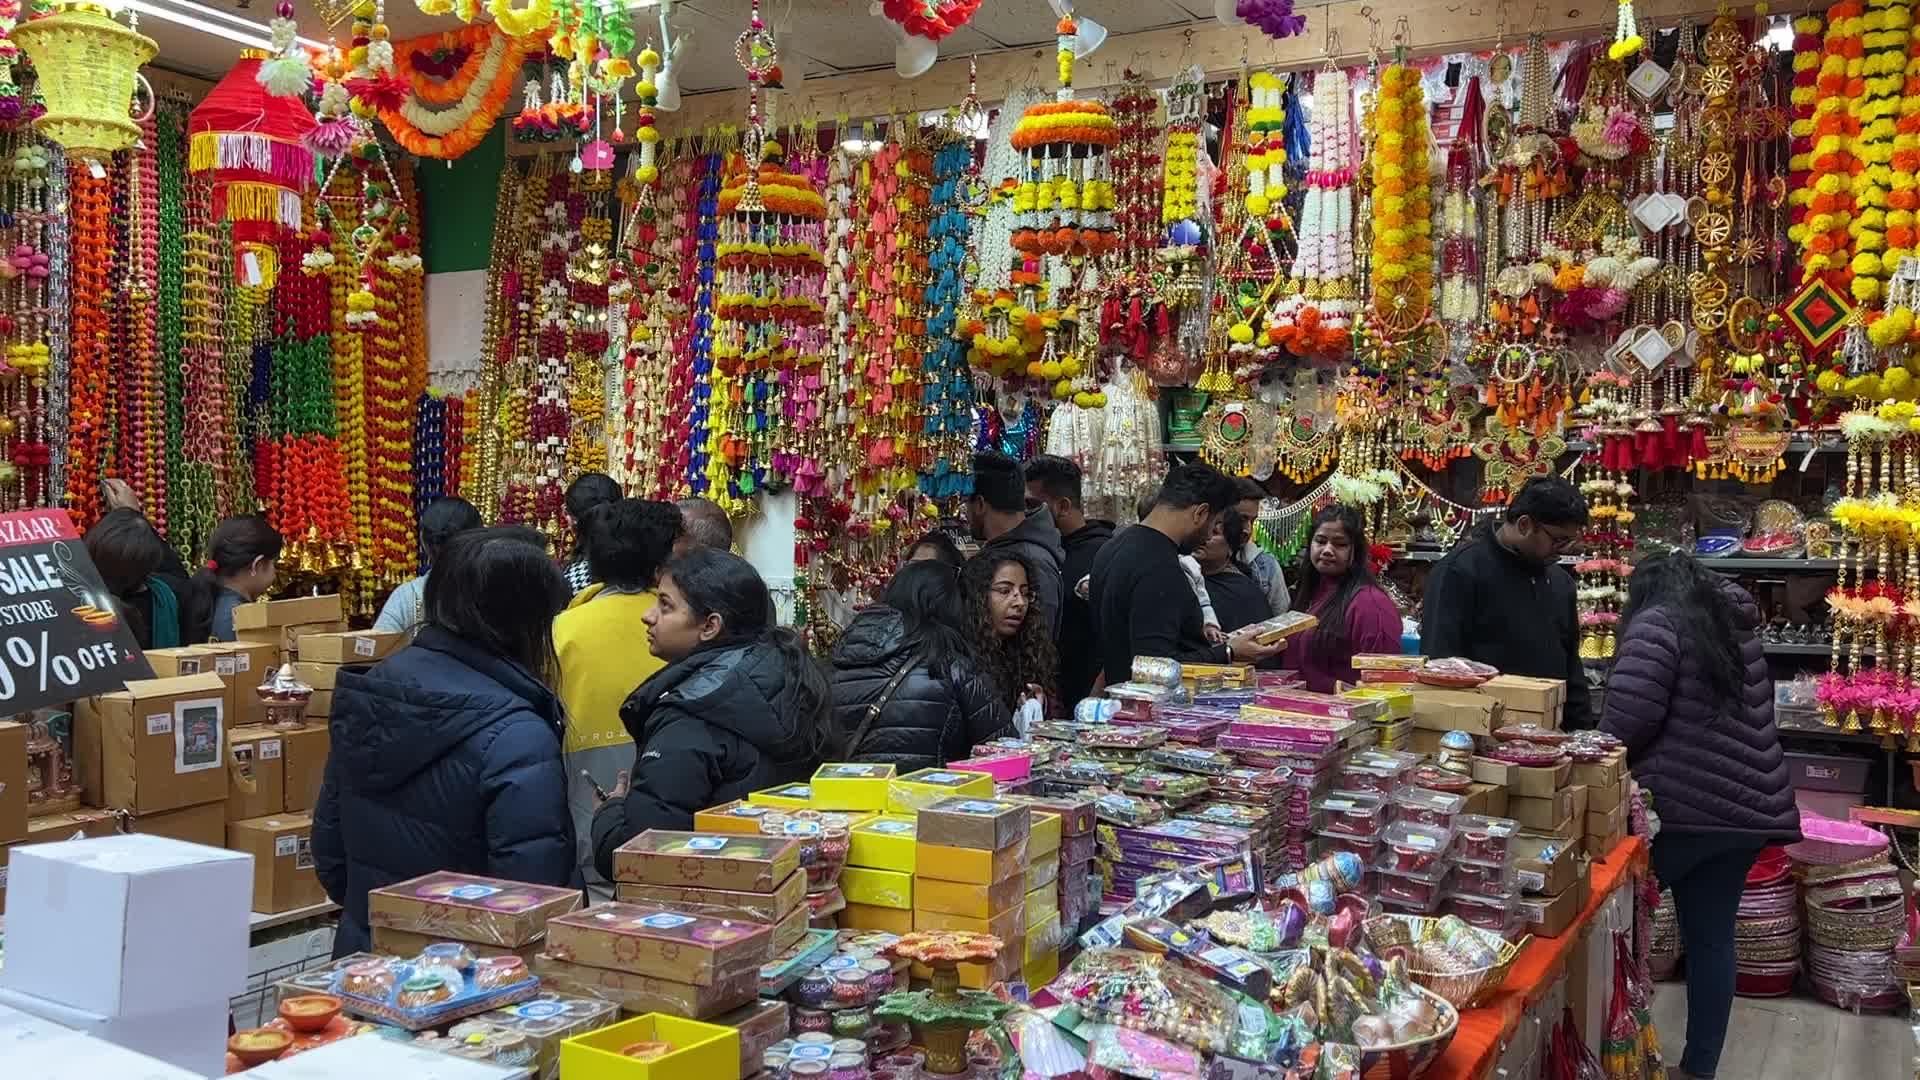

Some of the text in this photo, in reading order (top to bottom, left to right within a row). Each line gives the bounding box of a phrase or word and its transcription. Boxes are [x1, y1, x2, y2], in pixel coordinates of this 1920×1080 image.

[0, 554, 64, 595] SALE
[1, 600, 58, 624] STORE
[77, 642, 118, 670] OFF
